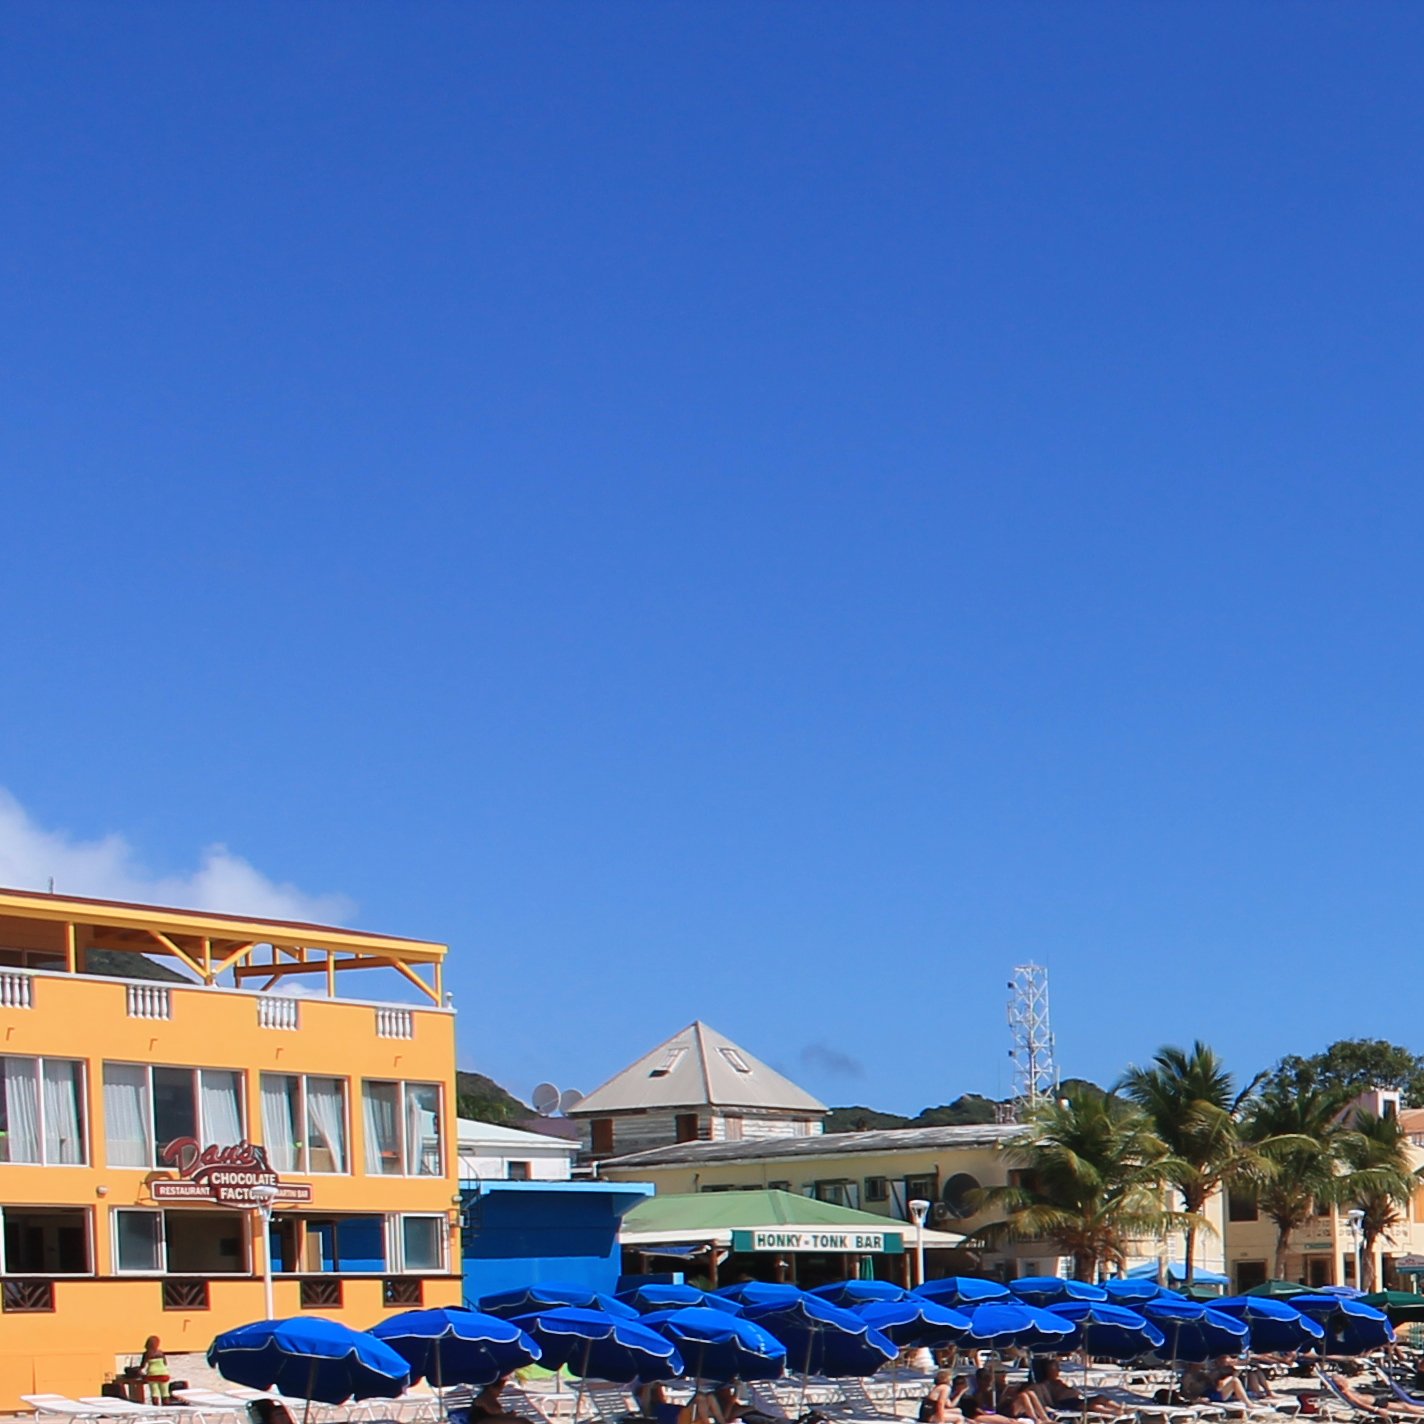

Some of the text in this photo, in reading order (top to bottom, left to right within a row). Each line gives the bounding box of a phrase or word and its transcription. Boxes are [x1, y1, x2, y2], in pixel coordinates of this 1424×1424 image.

[212, 1172, 277, 1186] CHOCOLATE
[159, 1186, 211, 1196] RESTAURANT
[855, 1234, 882, 1249] BAR
